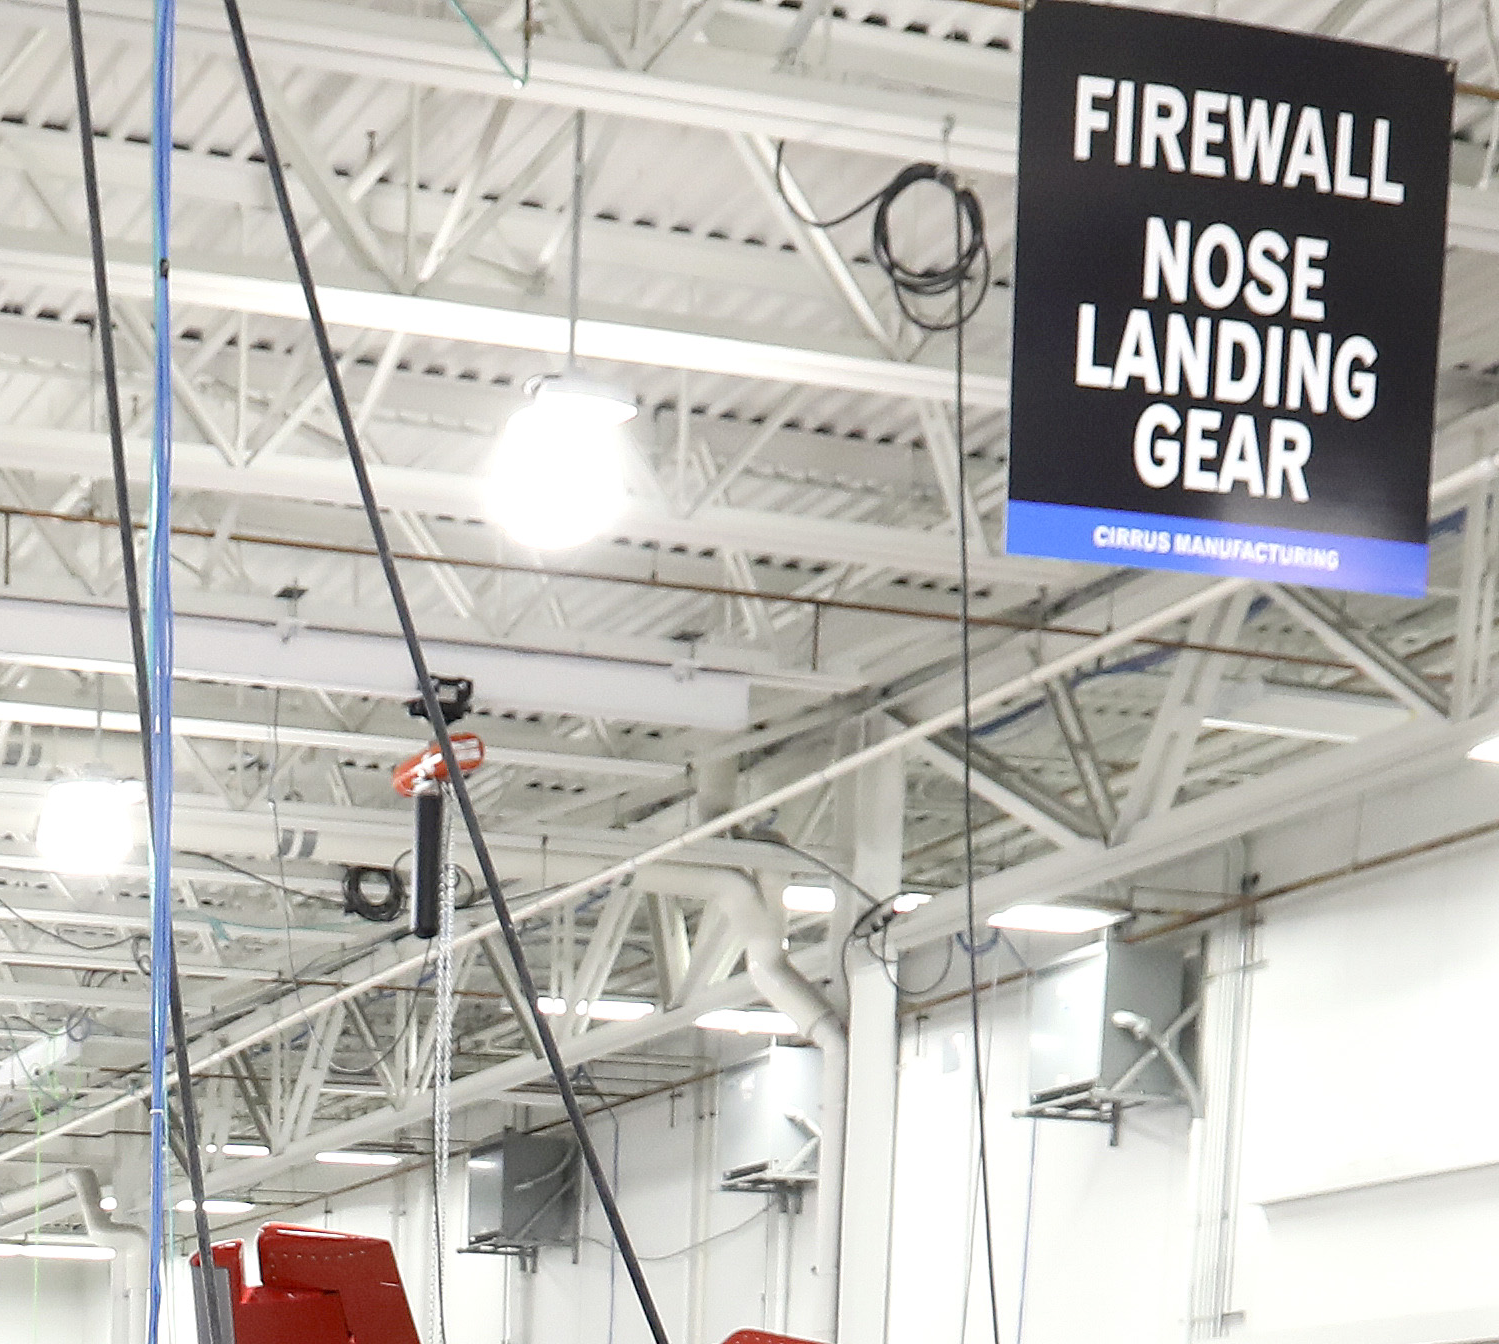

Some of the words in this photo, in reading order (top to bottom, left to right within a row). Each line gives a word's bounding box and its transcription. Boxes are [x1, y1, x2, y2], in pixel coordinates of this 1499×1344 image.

[1072, 74, 1404, 205] FIREWALL
[1142, 216, 1329, 321] NOSE
[1074, 303, 1378, 420] LANDING
[1132, 403, 1312, 502] GEAR
[1093, 525, 1170, 554] CIRRUS
[1174, 533, 1340, 571] MANUFACTURING
